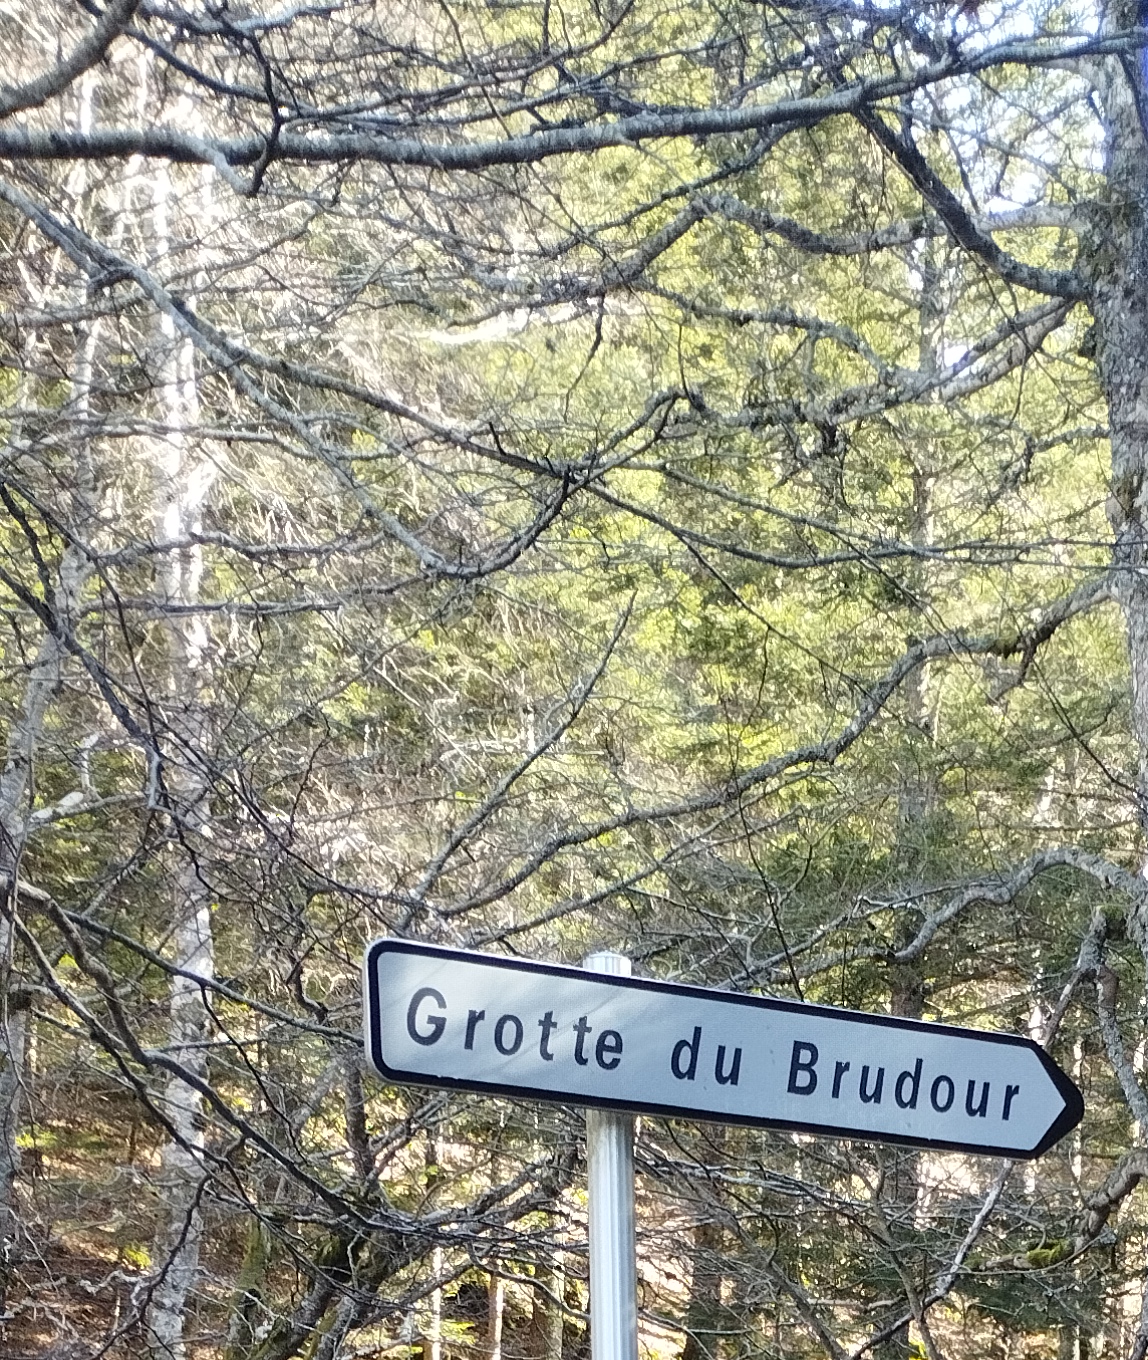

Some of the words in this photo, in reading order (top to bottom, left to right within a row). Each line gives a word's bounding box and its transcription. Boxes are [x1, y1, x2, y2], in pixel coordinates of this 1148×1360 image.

[406, 986, 624, 1070] Grotte
[670, 1026, 742, 1086] du
[787, 1040, 1020, 1121] Brudour
